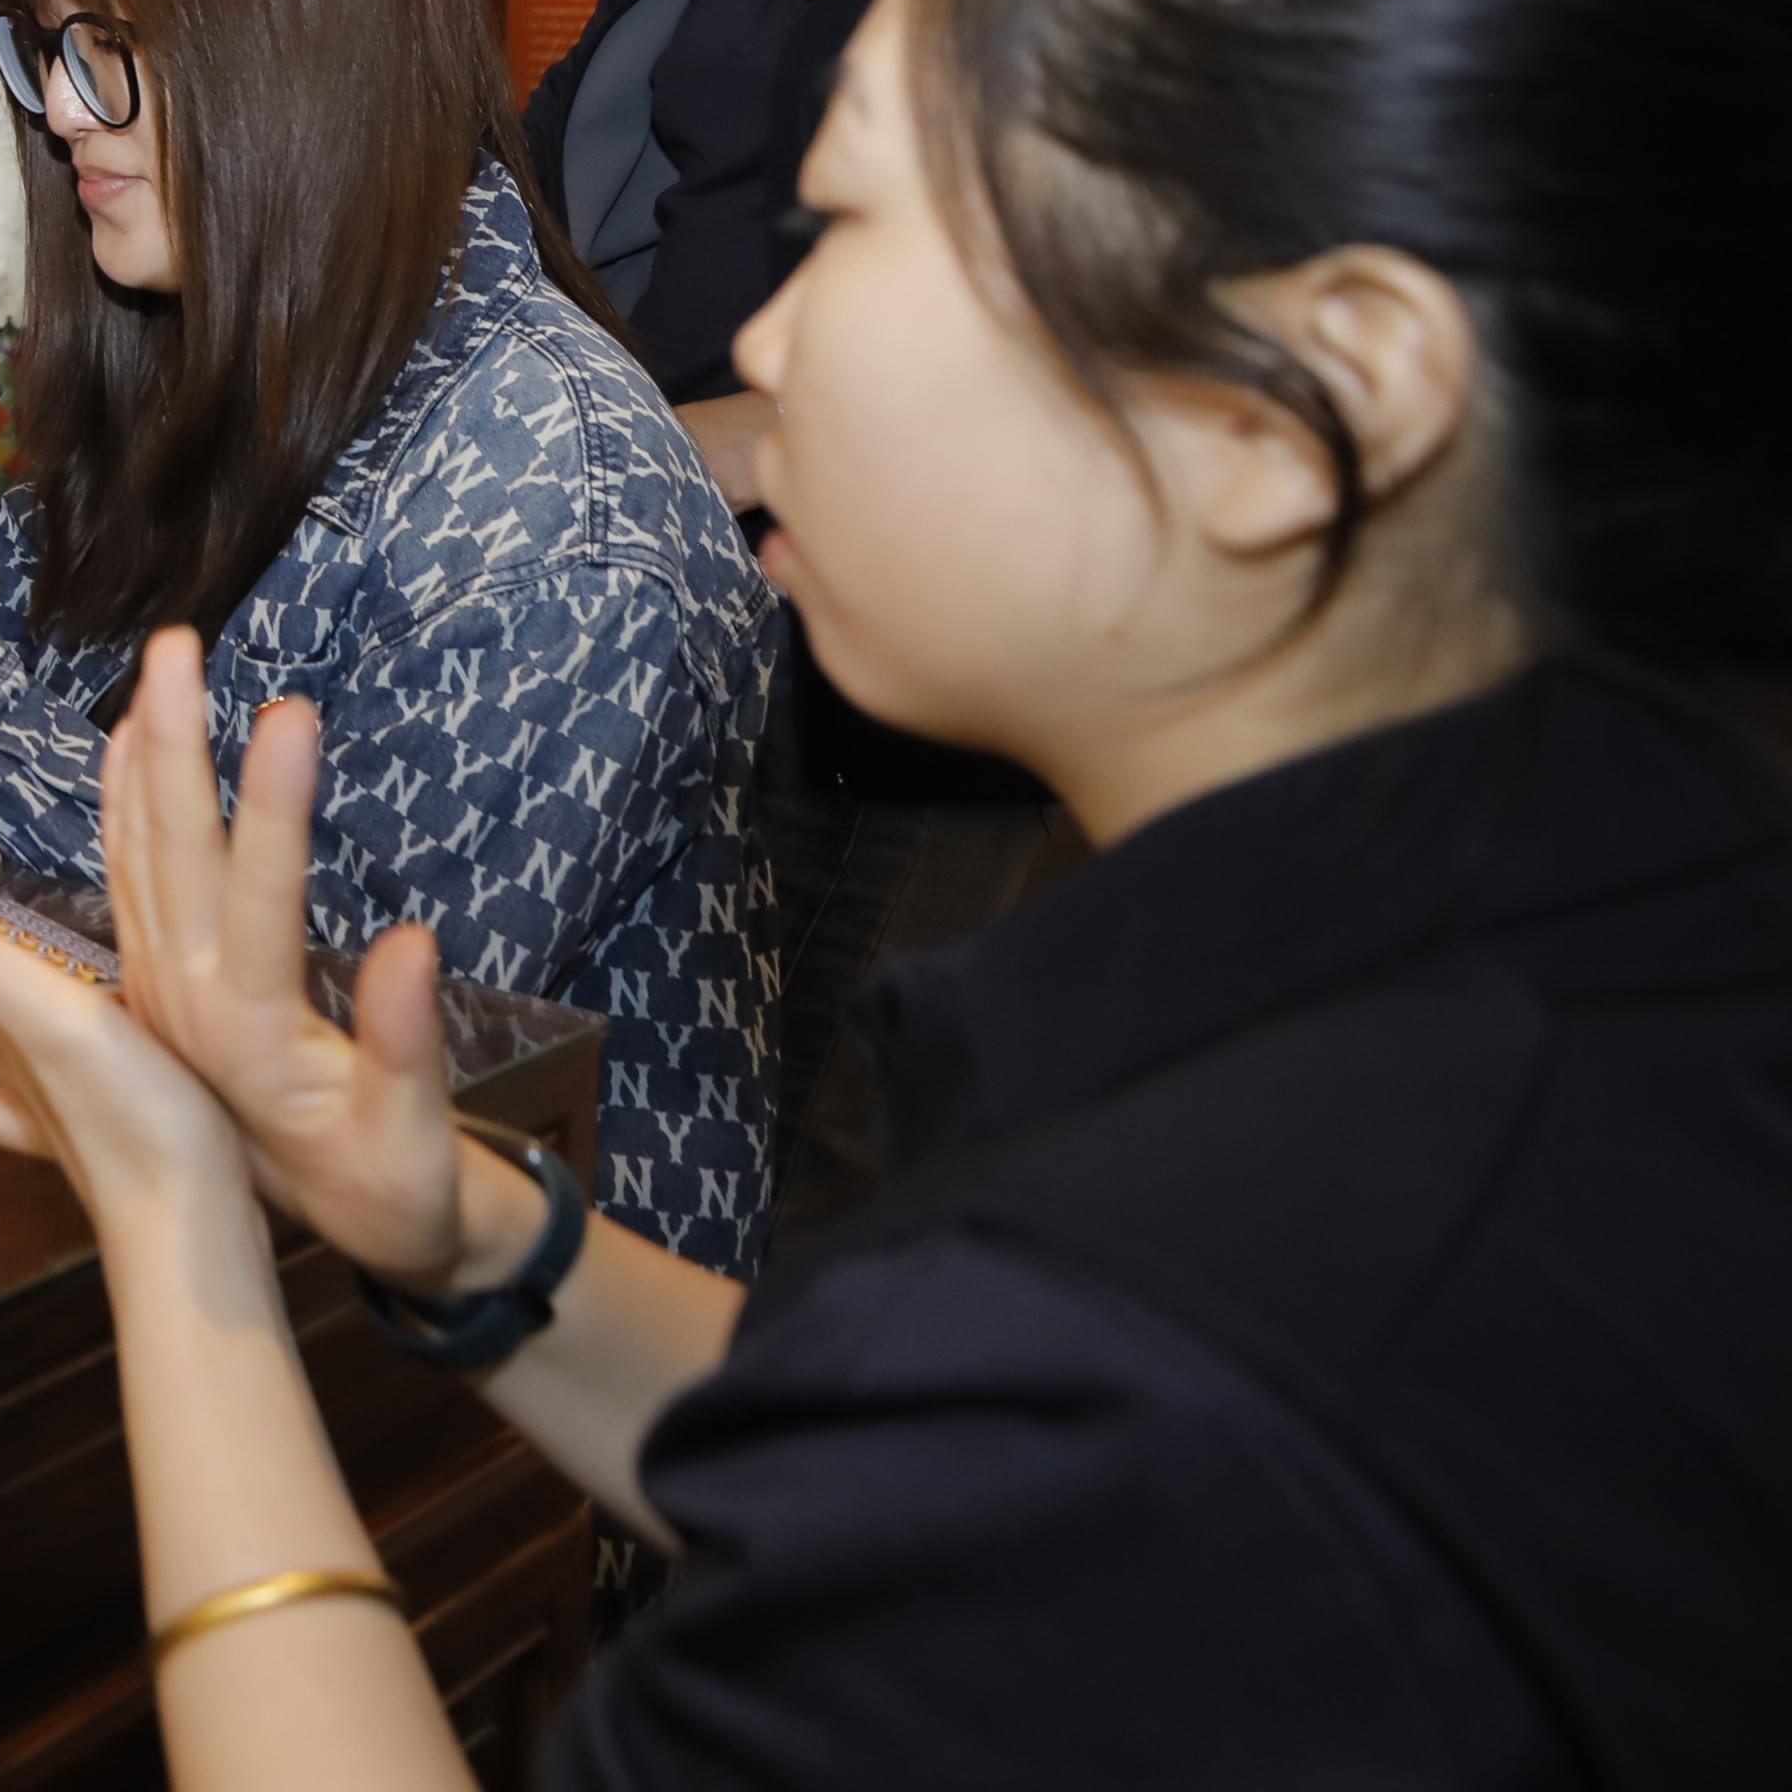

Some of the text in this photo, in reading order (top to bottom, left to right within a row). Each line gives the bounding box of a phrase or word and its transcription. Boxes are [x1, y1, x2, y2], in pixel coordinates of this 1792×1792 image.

[526, 394, 582, 448] N
[438, 432, 497, 499] N
[507, 453, 558, 492] Y
[426, 501, 474, 547] Y
[472, 508, 531, 564] N
[249, 599, 287, 647] N
[616, 606, 658, 648] Y
[440, 648, 483, 691] N
[617, 657, 663, 709] N
[1, 719, 45, 760] Y
[46, 726, 94, 765] N
[499, 720, 547, 771] N
[652, 739, 682, 790] Y
[5, 767, 60, 816] N
[372, 755, 430, 812] N
[449, 740, 492, 793] Y
[561, 744, 621, 809] N
[322, 771, 367, 819] Y
[514, 775, 555, 828] Y
[713, 786, 740, 836] N
[443, 803, 499, 859] N
[613, 830, 641, 882] Y
[331, 835, 376, 887] N
[515, 837, 577, 903] N
[748, 859, 776, 909] N
[467, 864, 509, 919] Y
[697, 882, 736, 933] N
[472, 930, 530, 990] N
[658, 926, 693, 978] Y
[755, 949, 780, 1003] N
[609, 967, 651, 1018] N
[697, 978, 738, 1029] N
[657, 1021, 692, 1069] Y
[609, 1060, 651, 1108] N
[697, 1073, 741, 1122] N
[655, 1110, 692, 1164] Y
[745, 1122, 769, 1173] Y
[611, 1153, 653, 1208] N
[697, 1167, 740, 1218] N
[735, 1215, 751, 1260] Y
